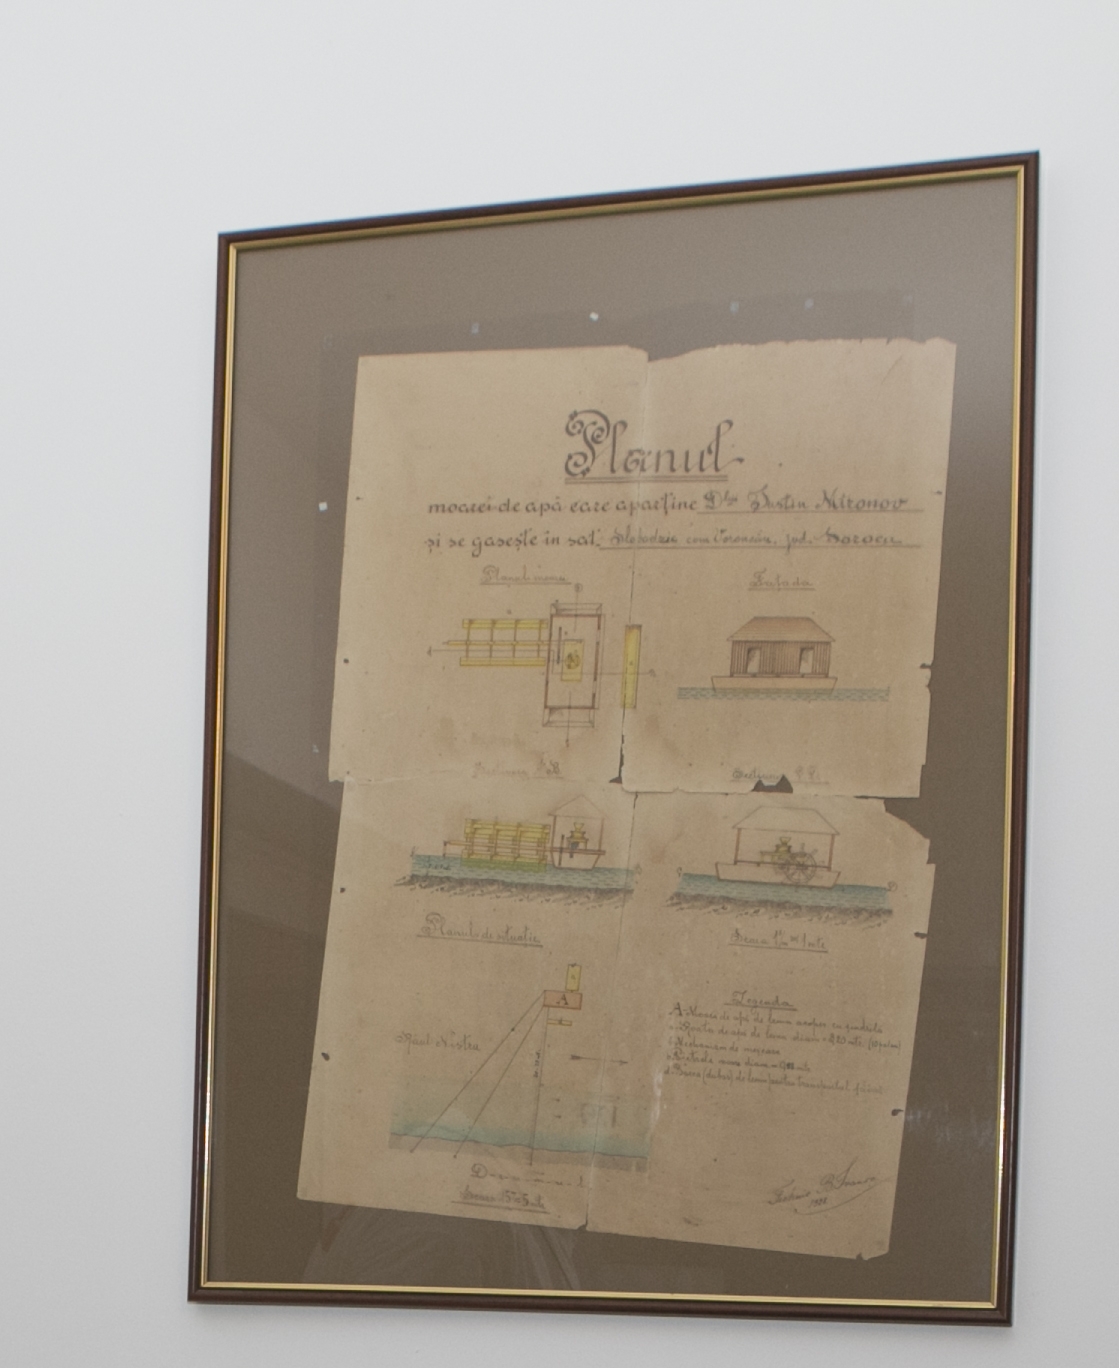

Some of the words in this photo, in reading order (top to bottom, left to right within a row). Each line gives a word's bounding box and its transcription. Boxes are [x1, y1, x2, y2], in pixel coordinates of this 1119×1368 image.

[564, 408, 744, 480] Planul
[498, 498, 521, 513] de
[570, 501, 611, 513] care
[448, 537, 466, 548] se
